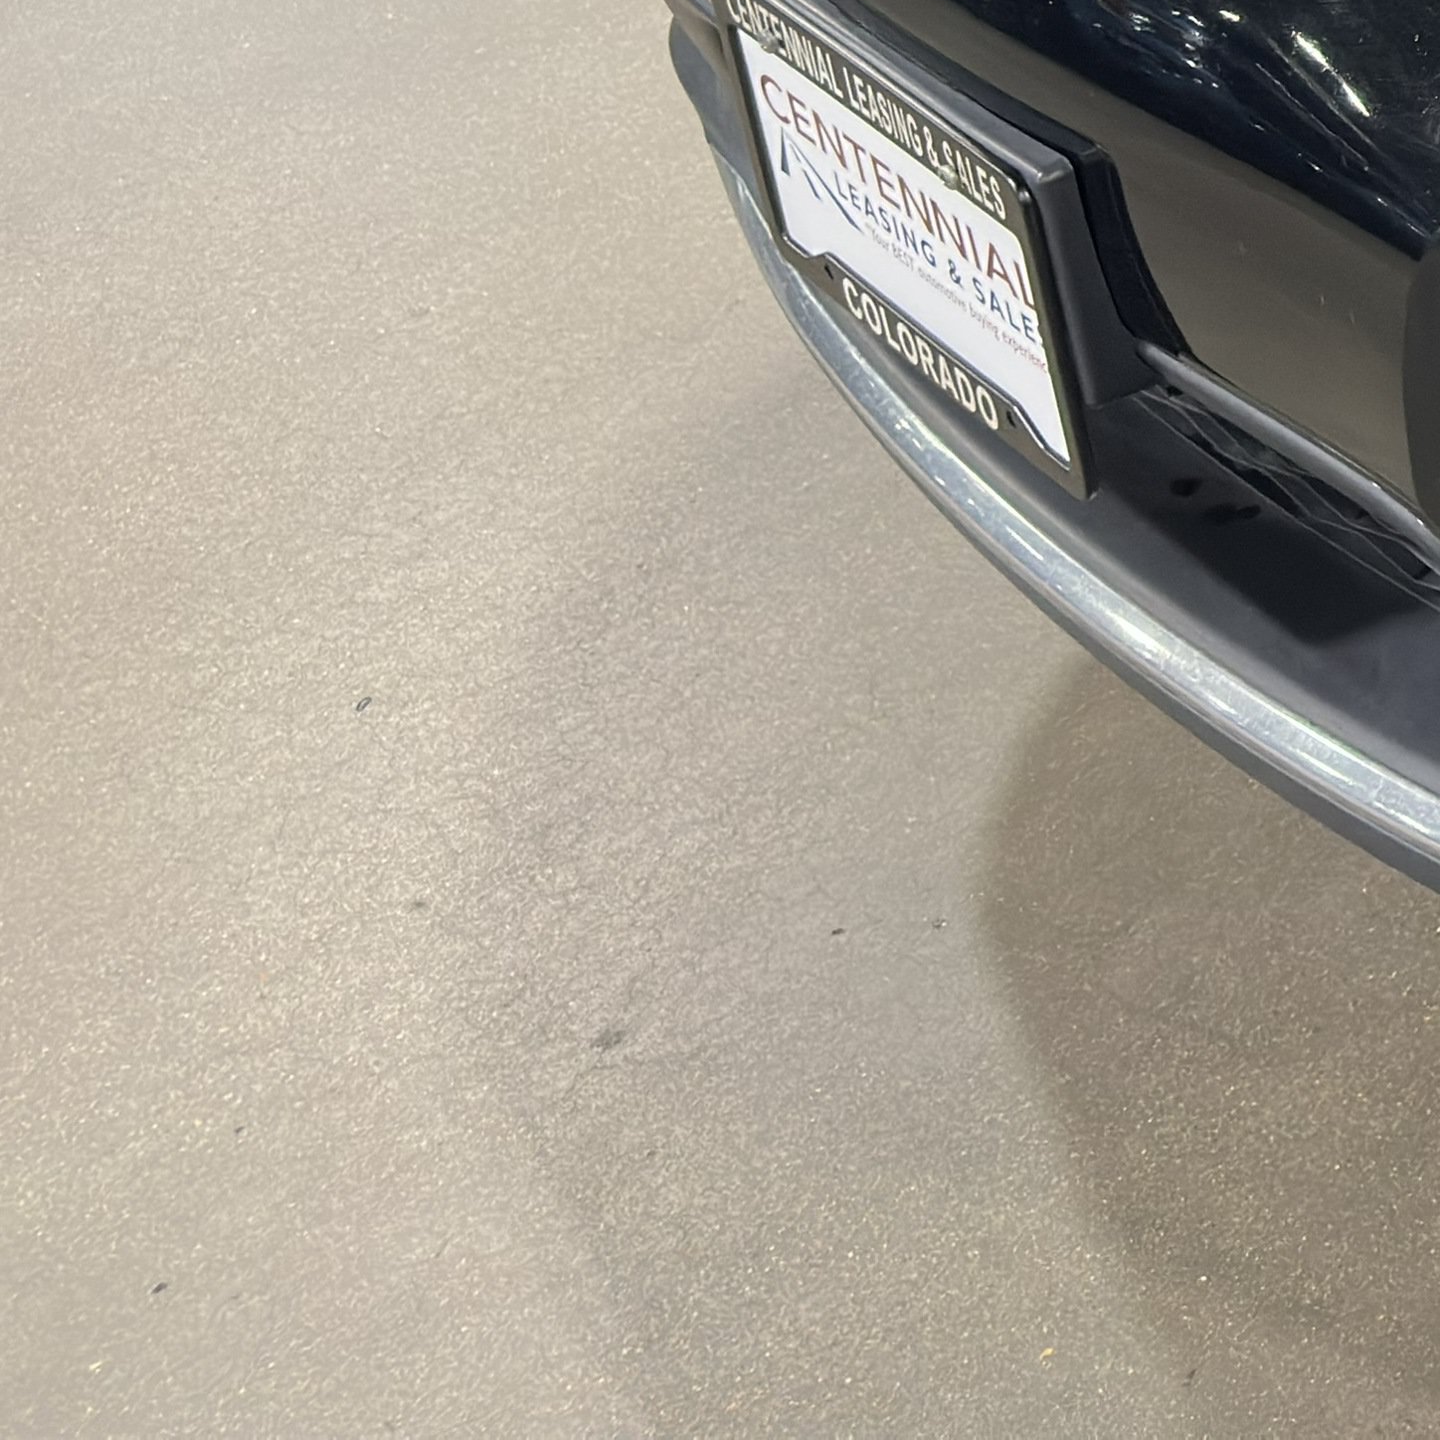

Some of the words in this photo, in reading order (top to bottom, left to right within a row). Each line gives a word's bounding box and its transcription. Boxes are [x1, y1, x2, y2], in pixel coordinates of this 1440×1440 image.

[843, 66, 923, 156] LEASING
[921, 125, 938, 166] &
[761, 74, 1036, 312] CENTENNIAL
[833, 171, 937, 268] LEASING
[947, 258, 965, 290] &
[842, 277, 999, 431] COLORADO
